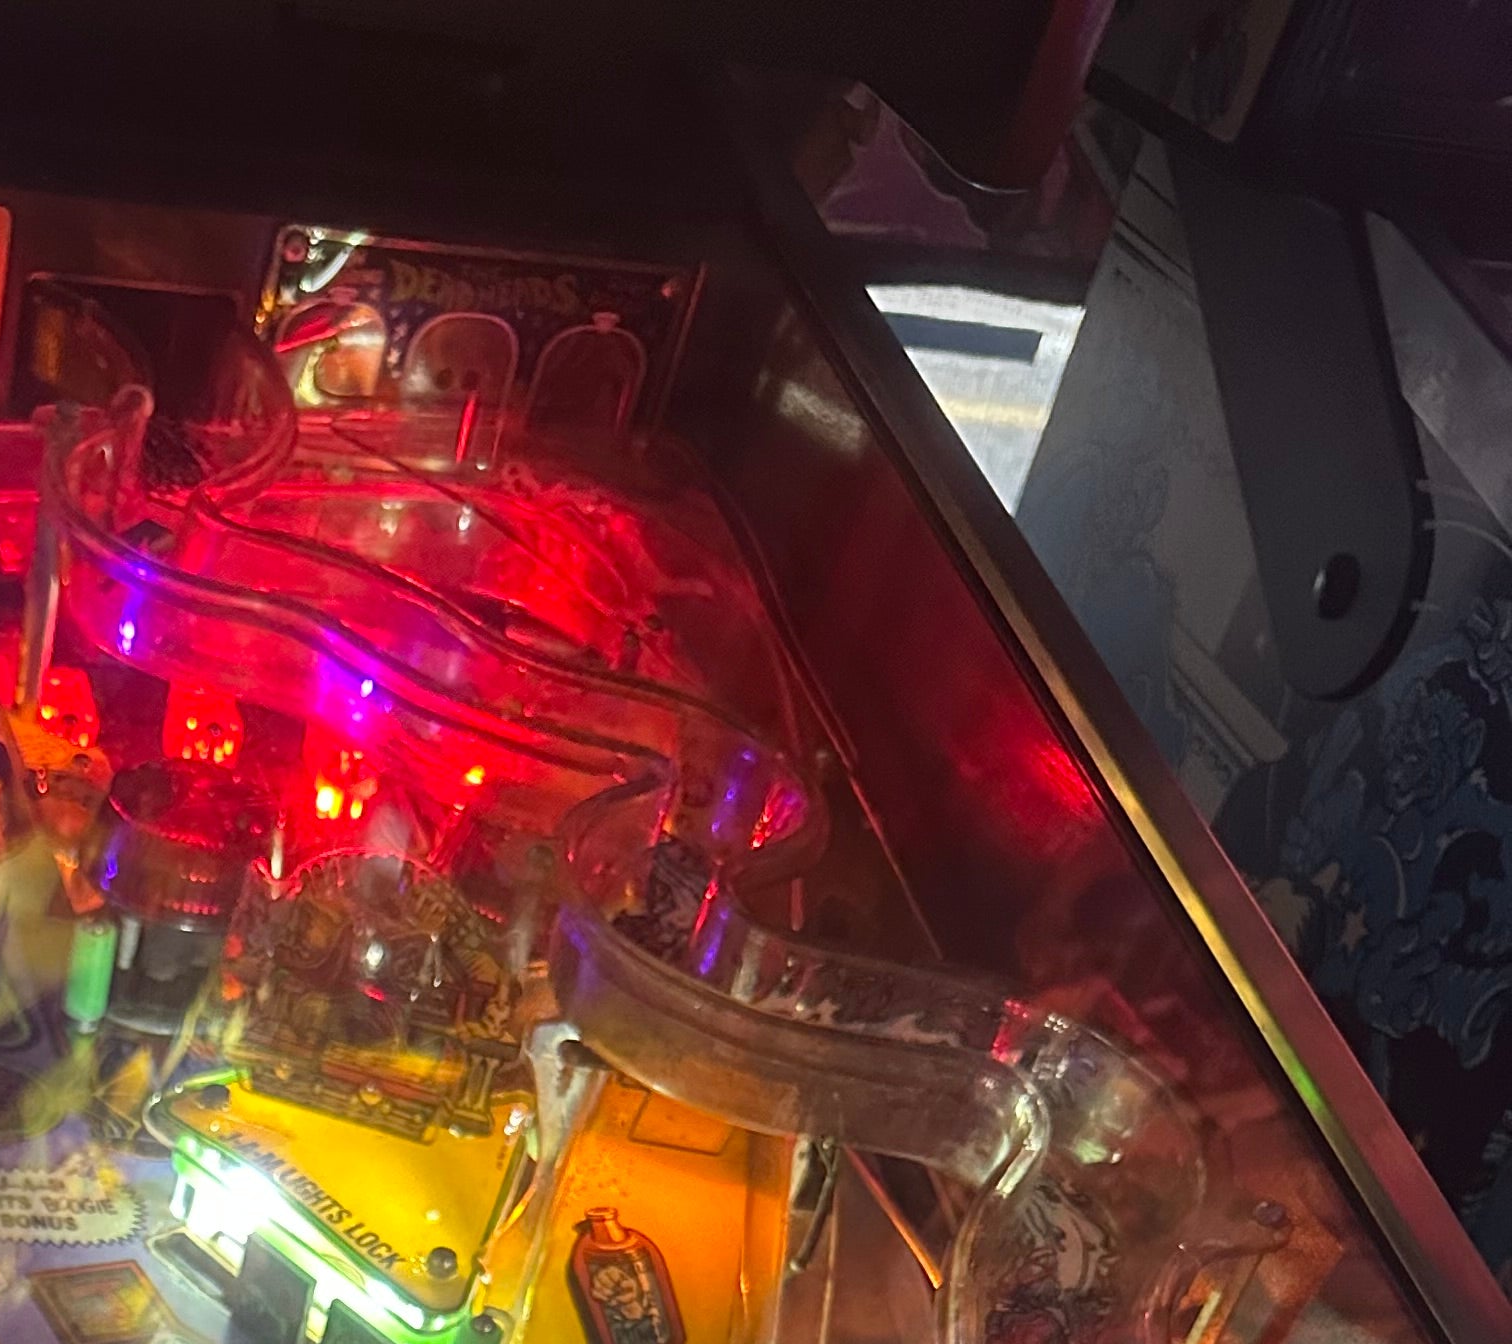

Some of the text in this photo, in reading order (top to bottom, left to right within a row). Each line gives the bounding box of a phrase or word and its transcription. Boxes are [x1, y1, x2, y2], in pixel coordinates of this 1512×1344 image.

[0, 1212, 79, 1231] BONUS
[278, 1169, 353, 1226] LIGHTS
[343, 1222, 407, 1270] LOCK
